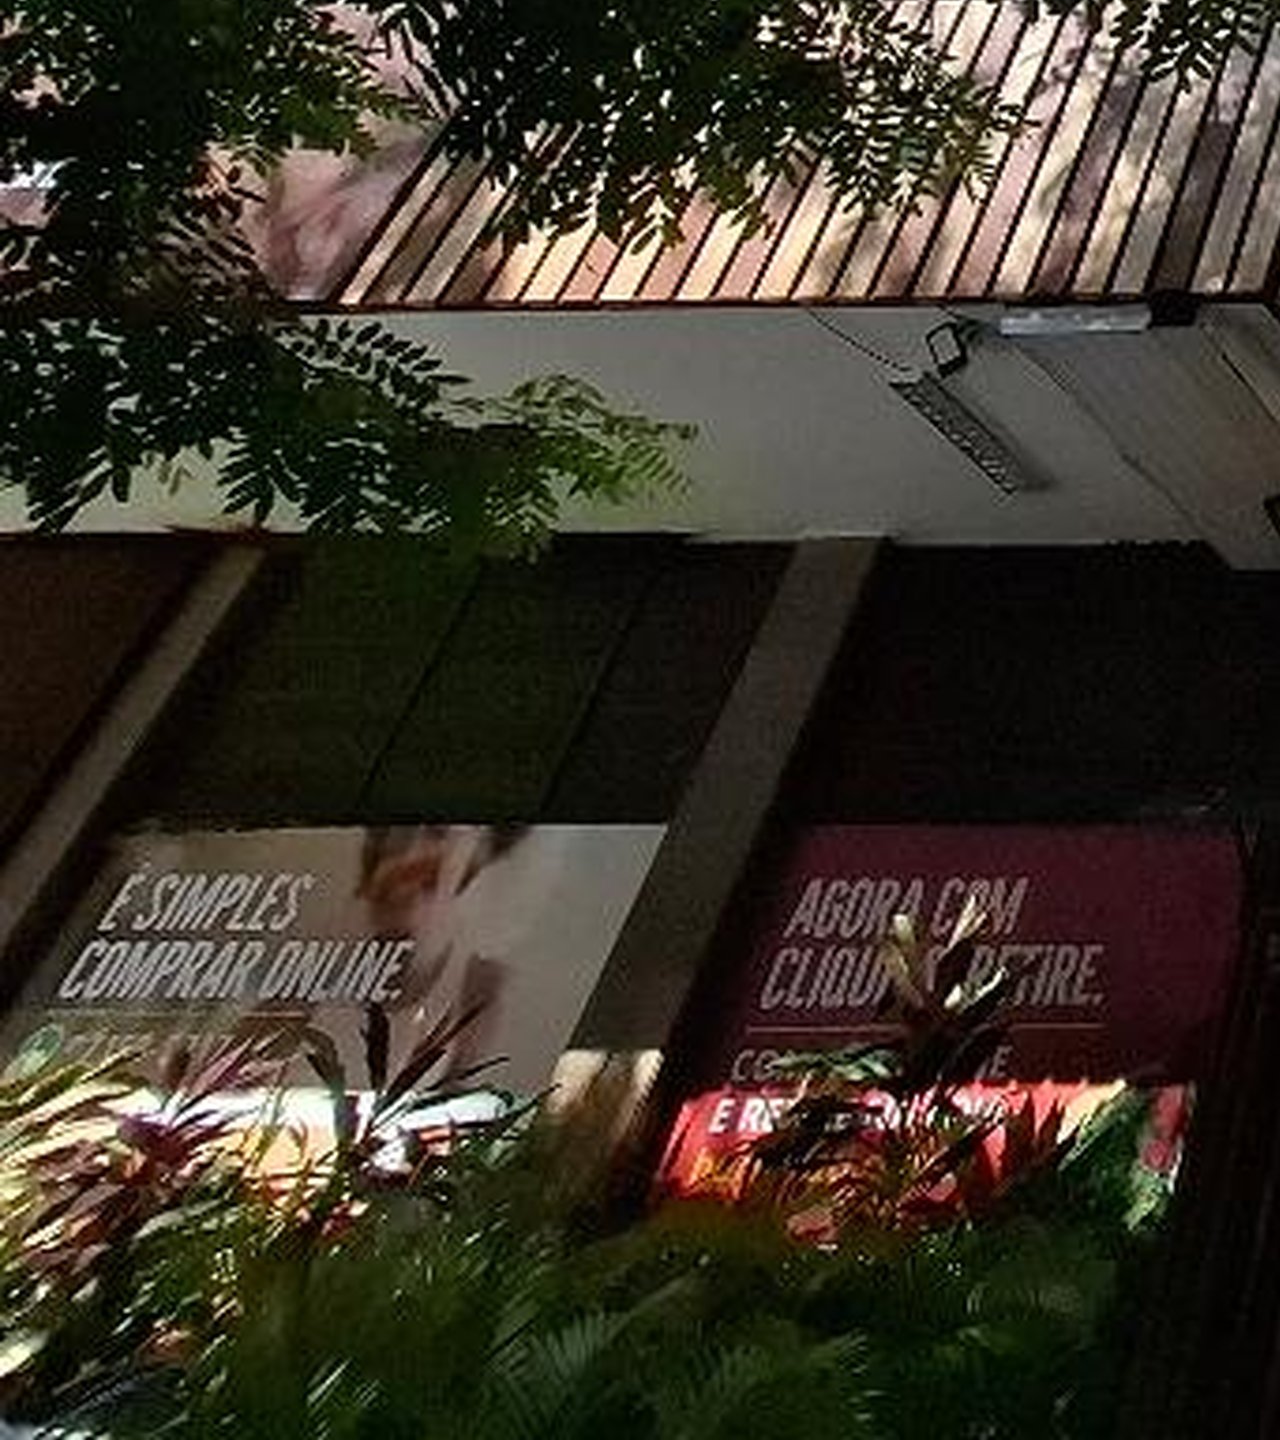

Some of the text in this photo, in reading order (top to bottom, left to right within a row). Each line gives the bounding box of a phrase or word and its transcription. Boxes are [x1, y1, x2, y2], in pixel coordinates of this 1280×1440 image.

[131, 872, 313, 931] SIMPLES
[783, 876, 923, 940] AGORA
[58, 938, 266, 1002] COMPRAR
[758, 943, 898, 1012] CLIQU
